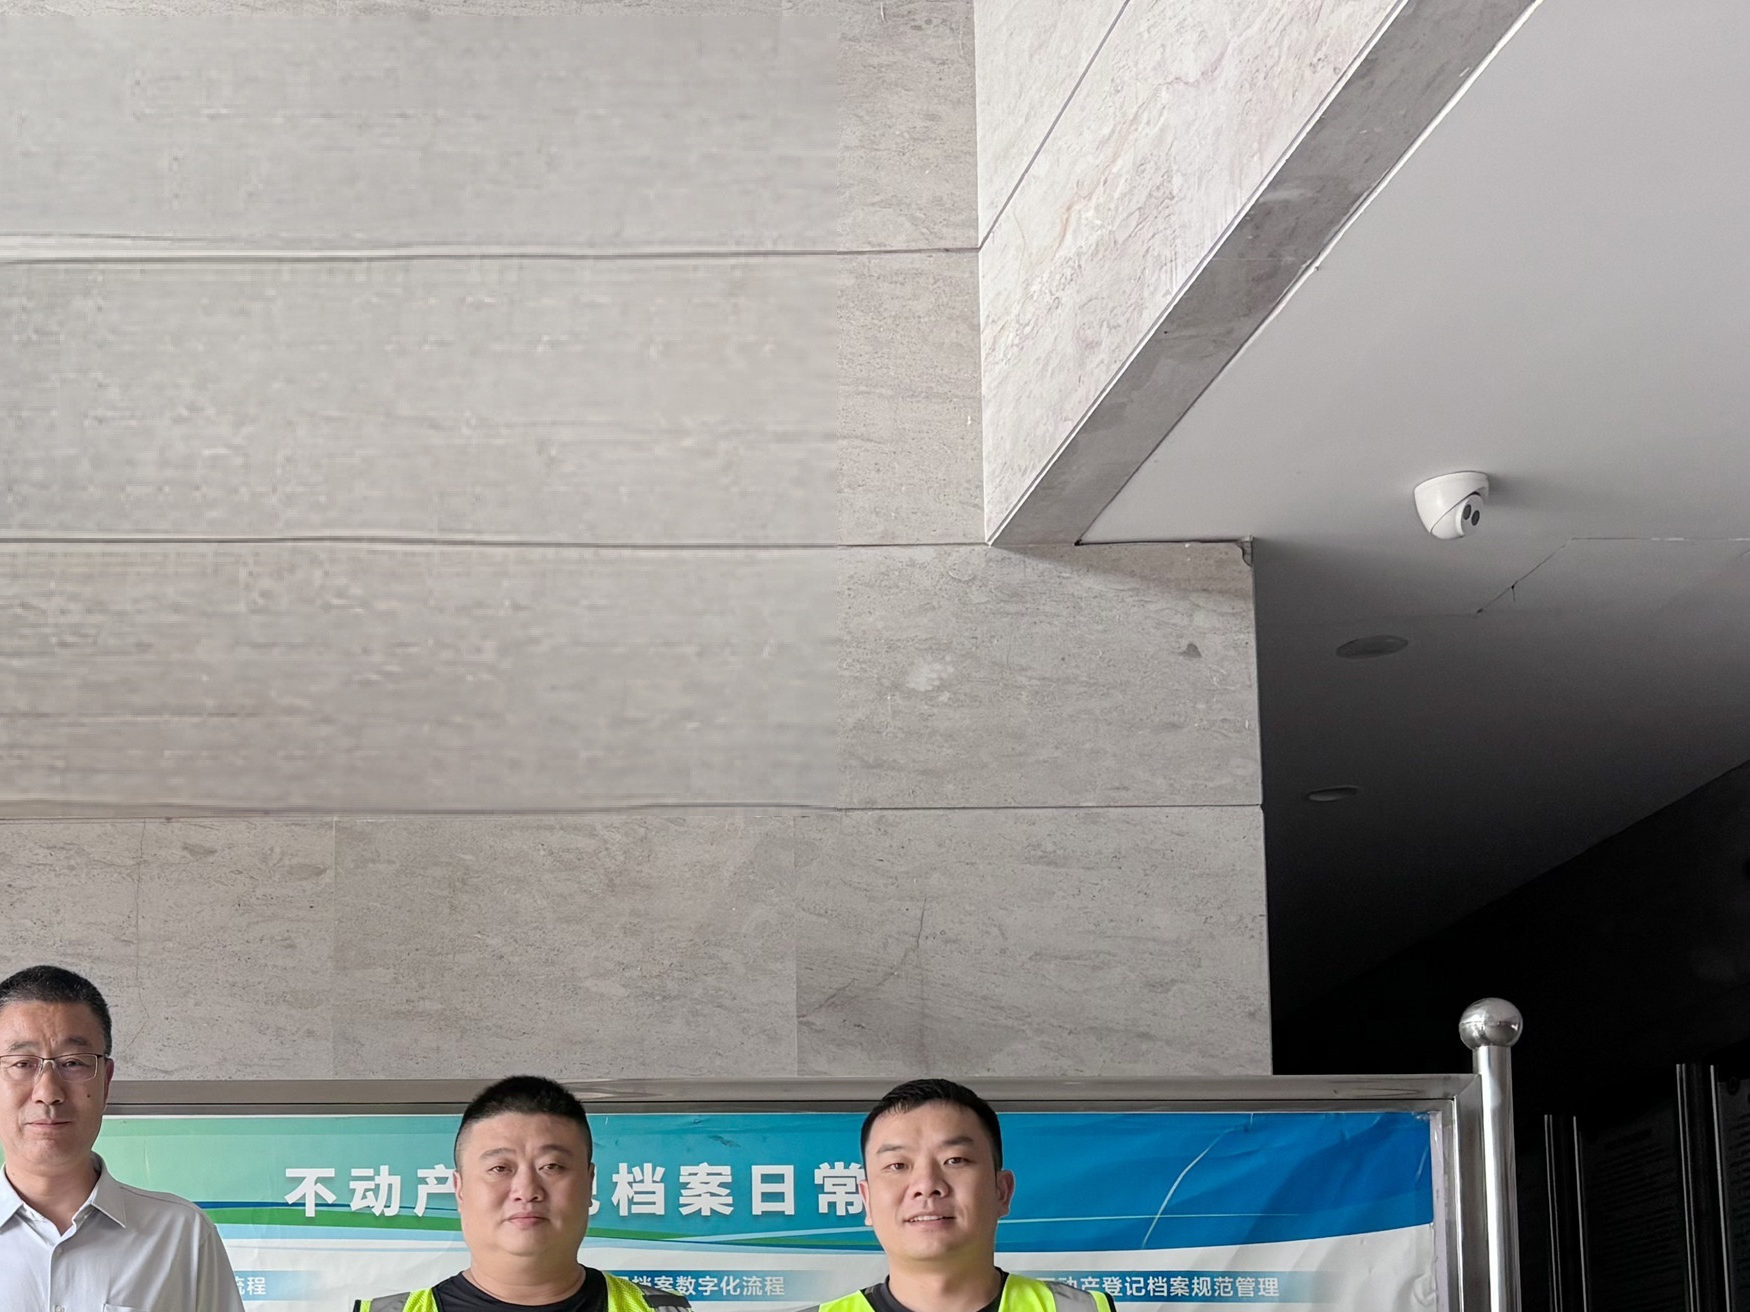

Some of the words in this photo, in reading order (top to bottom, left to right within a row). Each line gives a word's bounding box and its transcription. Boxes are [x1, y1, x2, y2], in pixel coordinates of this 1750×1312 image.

[284, 1162, 866, 1217] 不动产档案日常
